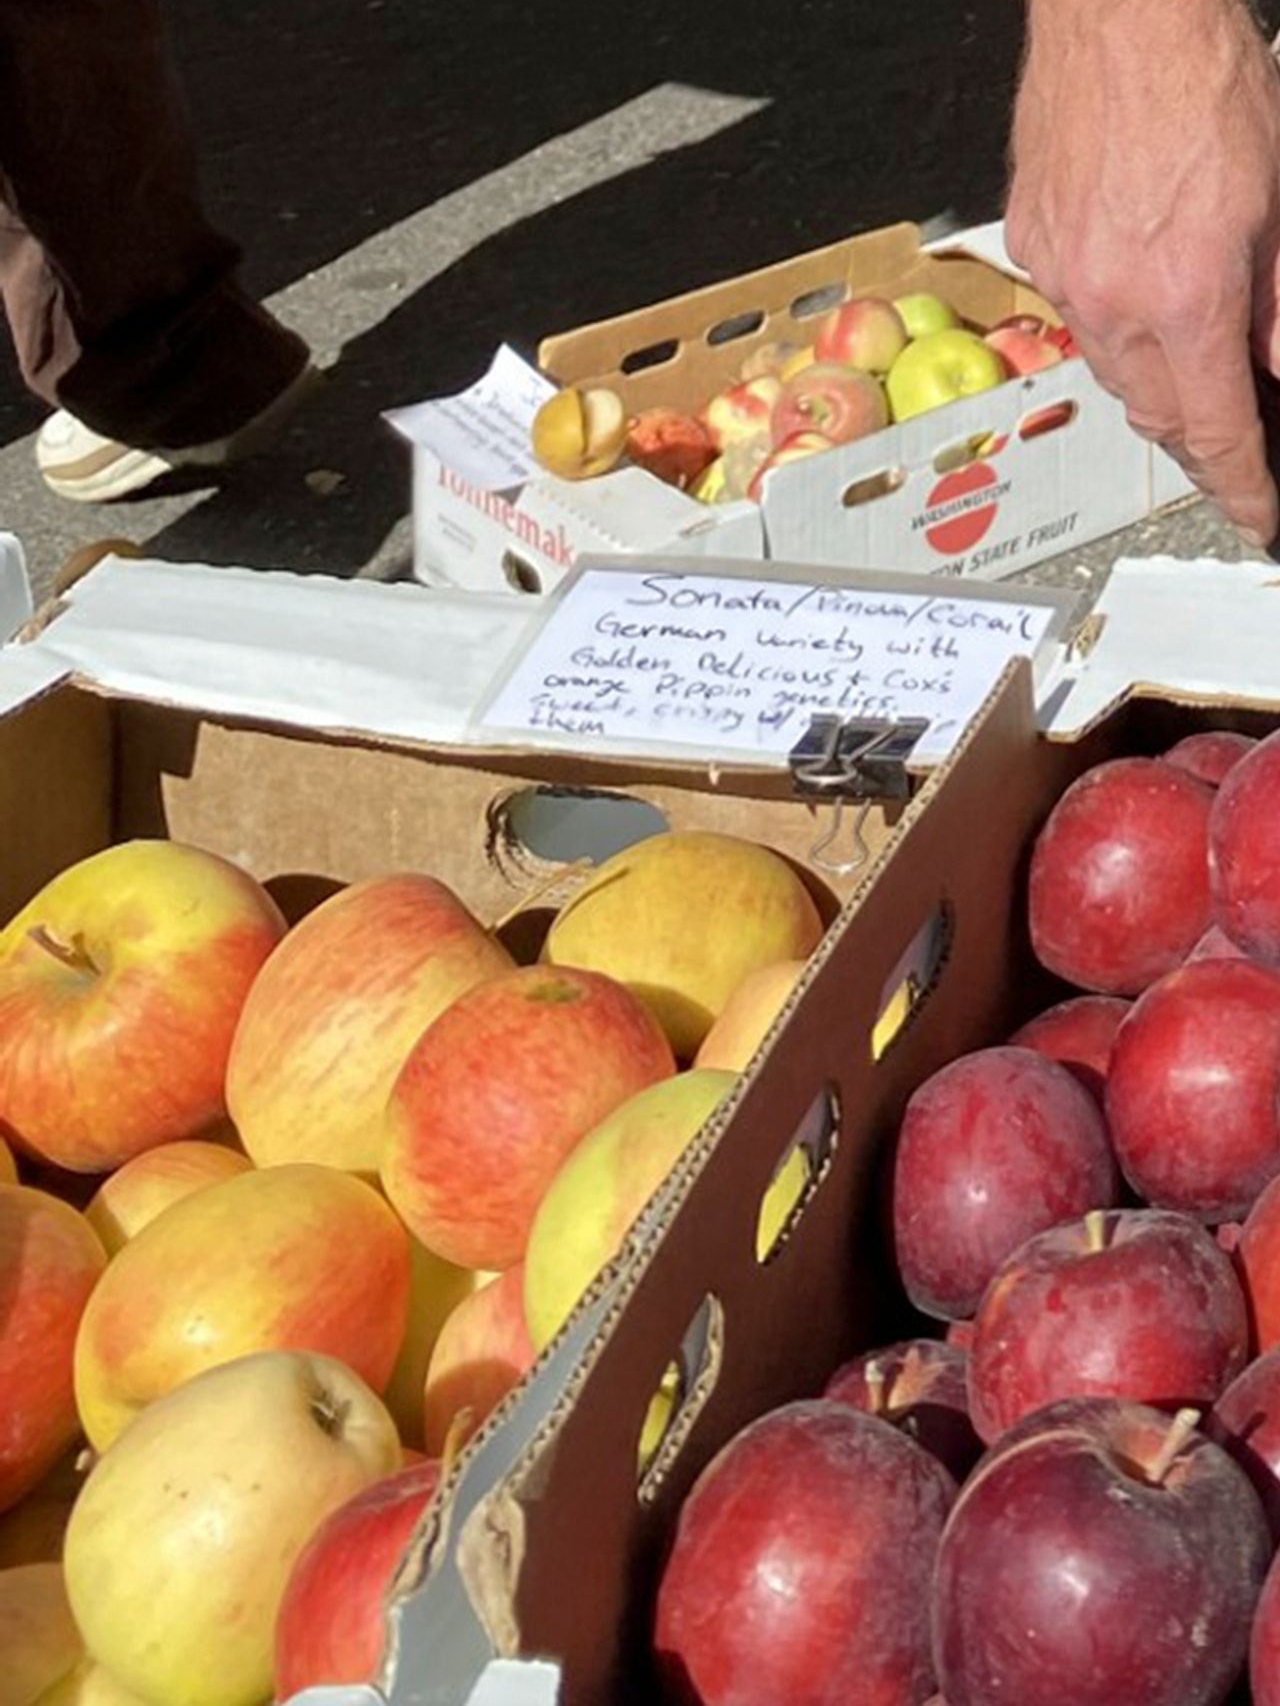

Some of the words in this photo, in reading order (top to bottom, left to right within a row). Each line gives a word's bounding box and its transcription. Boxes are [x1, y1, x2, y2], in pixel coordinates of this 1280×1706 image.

[910, 480, 1013, 531] WASHINGTON
[968, 535, 1021, 572] STATE
[1026, 511, 1080, 549] FRUIT
[594, 611, 727, 641] German
[757, 626, 864, 662] variety
[886, 635, 960, 658] with
[570, 645, 671, 671] Golden
[698, 651, 838, 686] Delicious
[655, 671, 751, 699] Pippin
